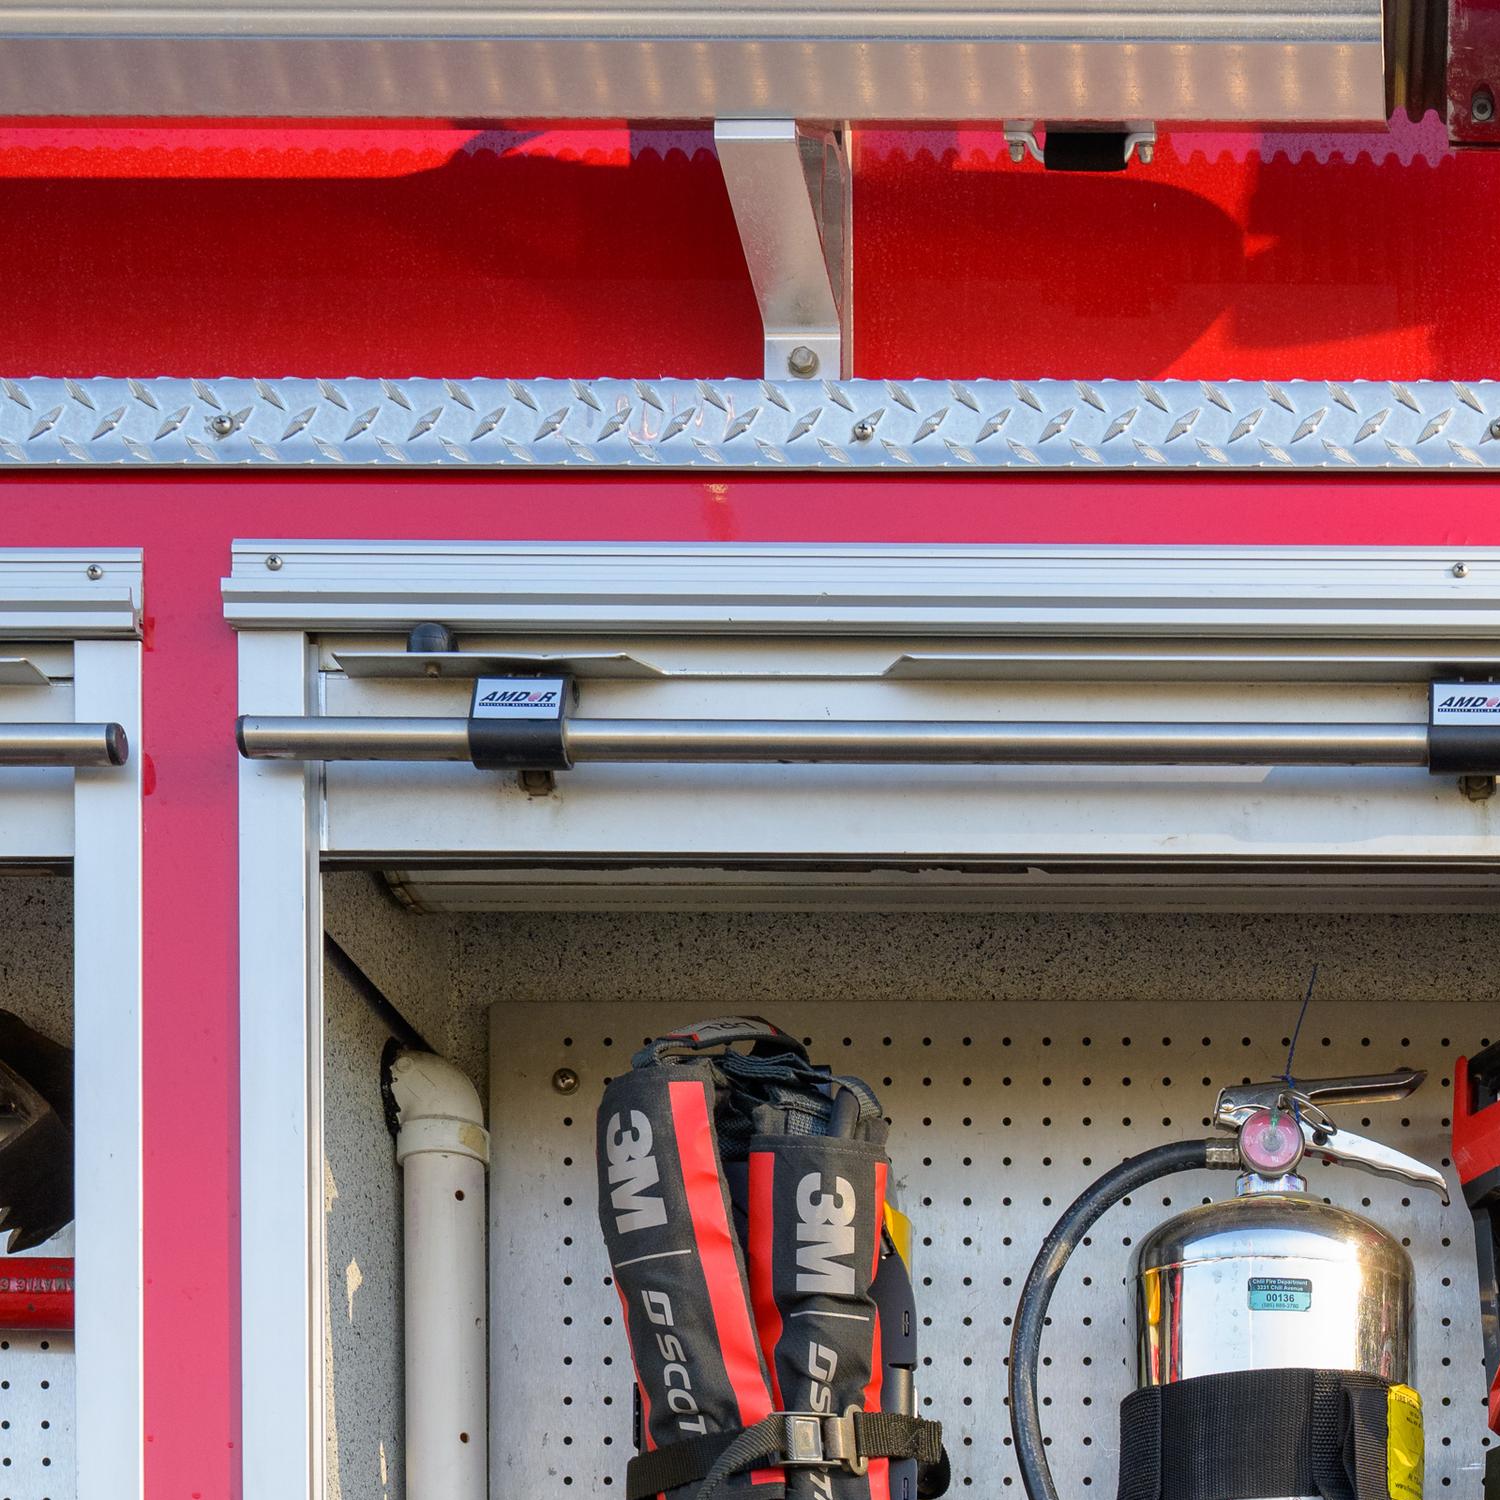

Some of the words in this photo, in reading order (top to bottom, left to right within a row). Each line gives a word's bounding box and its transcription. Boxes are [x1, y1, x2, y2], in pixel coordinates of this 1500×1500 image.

[606, 1110, 668, 1235] 3M
[796, 1171, 857, 1295] 3M
[1266, 1293, 1295, 1302] 00136
